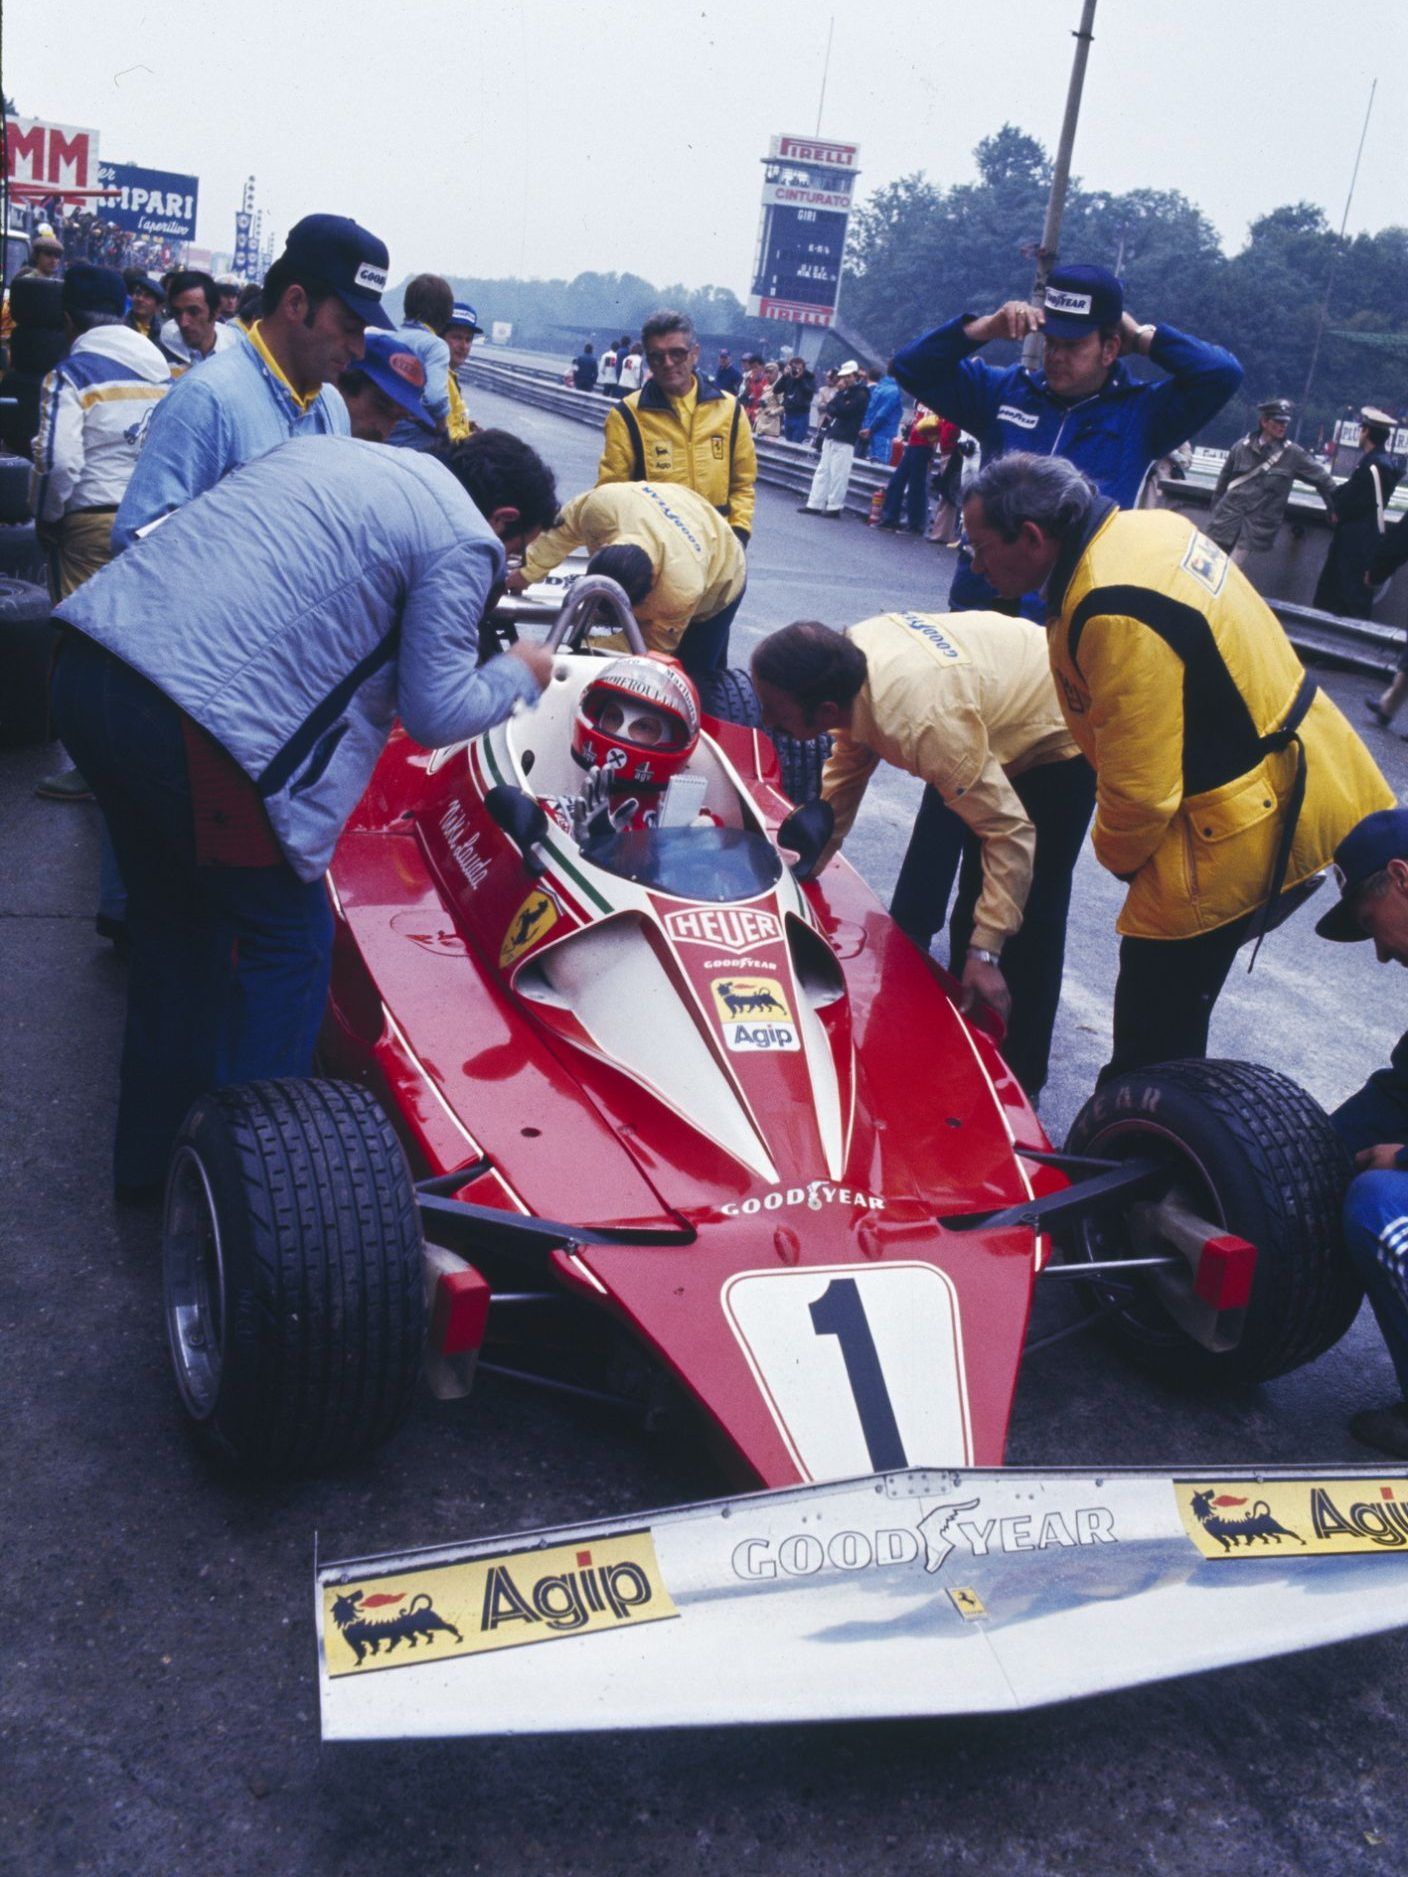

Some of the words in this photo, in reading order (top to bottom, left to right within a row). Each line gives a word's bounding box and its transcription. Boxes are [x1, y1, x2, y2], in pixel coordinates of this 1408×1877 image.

[3, 121, 89, 188] MM
[780, 136, 857, 166] PIRELLI
[774, 187, 850, 208] CINTURATO
[759, 297, 835, 327] PIRELLI
[453, 832, 493, 891] Lauda
[676, 911, 776, 948] HEUER
[703, 957, 777, 971] GOODYEAR
[734, 1024, 793, 1048] Agip
[721, 1181, 886, 1216] GOODYEAR
[808, 1277, 909, 1473] 1
[1311, 1486, 1408, 1547] Agi
[731, 1498, 1119, 1581] GOODYEAR
[480, 1550, 653, 1631] Agip
